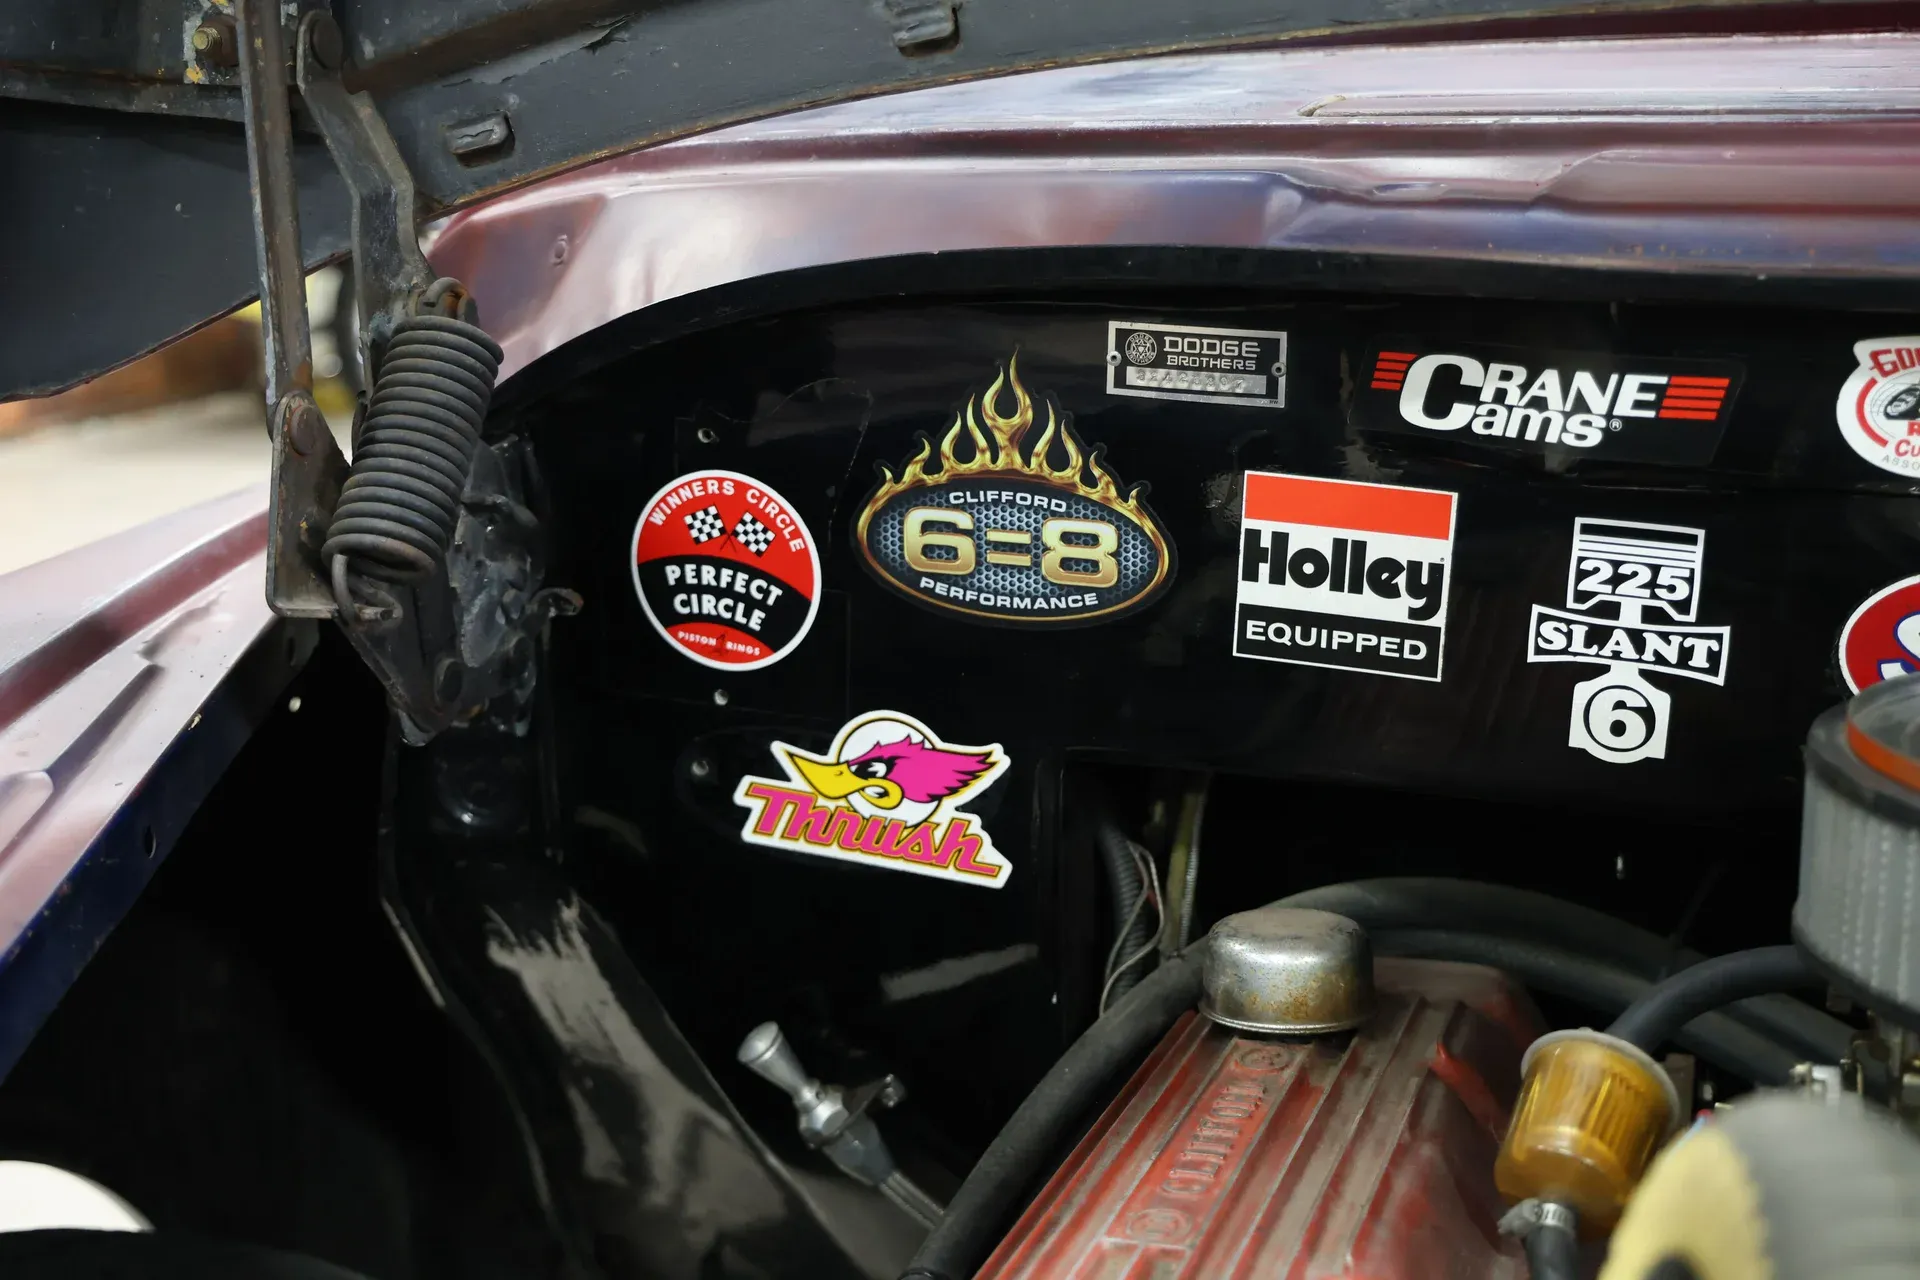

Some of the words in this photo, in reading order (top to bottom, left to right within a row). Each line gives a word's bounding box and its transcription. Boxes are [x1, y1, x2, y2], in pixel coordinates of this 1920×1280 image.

[1163, 336, 1261, 358] DODGE
[1166, 354, 1256, 371] BROTHERS
[1399, 353, 1669, 431] CRANE
[648, 479, 735, 526] WINNERS
[746, 488, 806, 552] CIRCLE
[949, 490, 1067, 513] CLIFFORD
[903, 506, 1119, 588] 6=8
[664, 563, 783, 606] PERFECT
[919, 576, 1099, 610] PERFORMANCE
[1241, 527, 1445, 621] Holley
[1576, 559, 1690, 601] 225
[673, 593, 766, 631] CIRCLE
[677, 631, 717, 646] PISTON
[726, 641, 760, 656] RINGS
[1246, 619, 1427, 660] EQUIPPED
[1537, 620, 1720, 668] SLANT
[1588, 688, 1648, 750] 6
[745, 782, 1002, 878] Thrush
